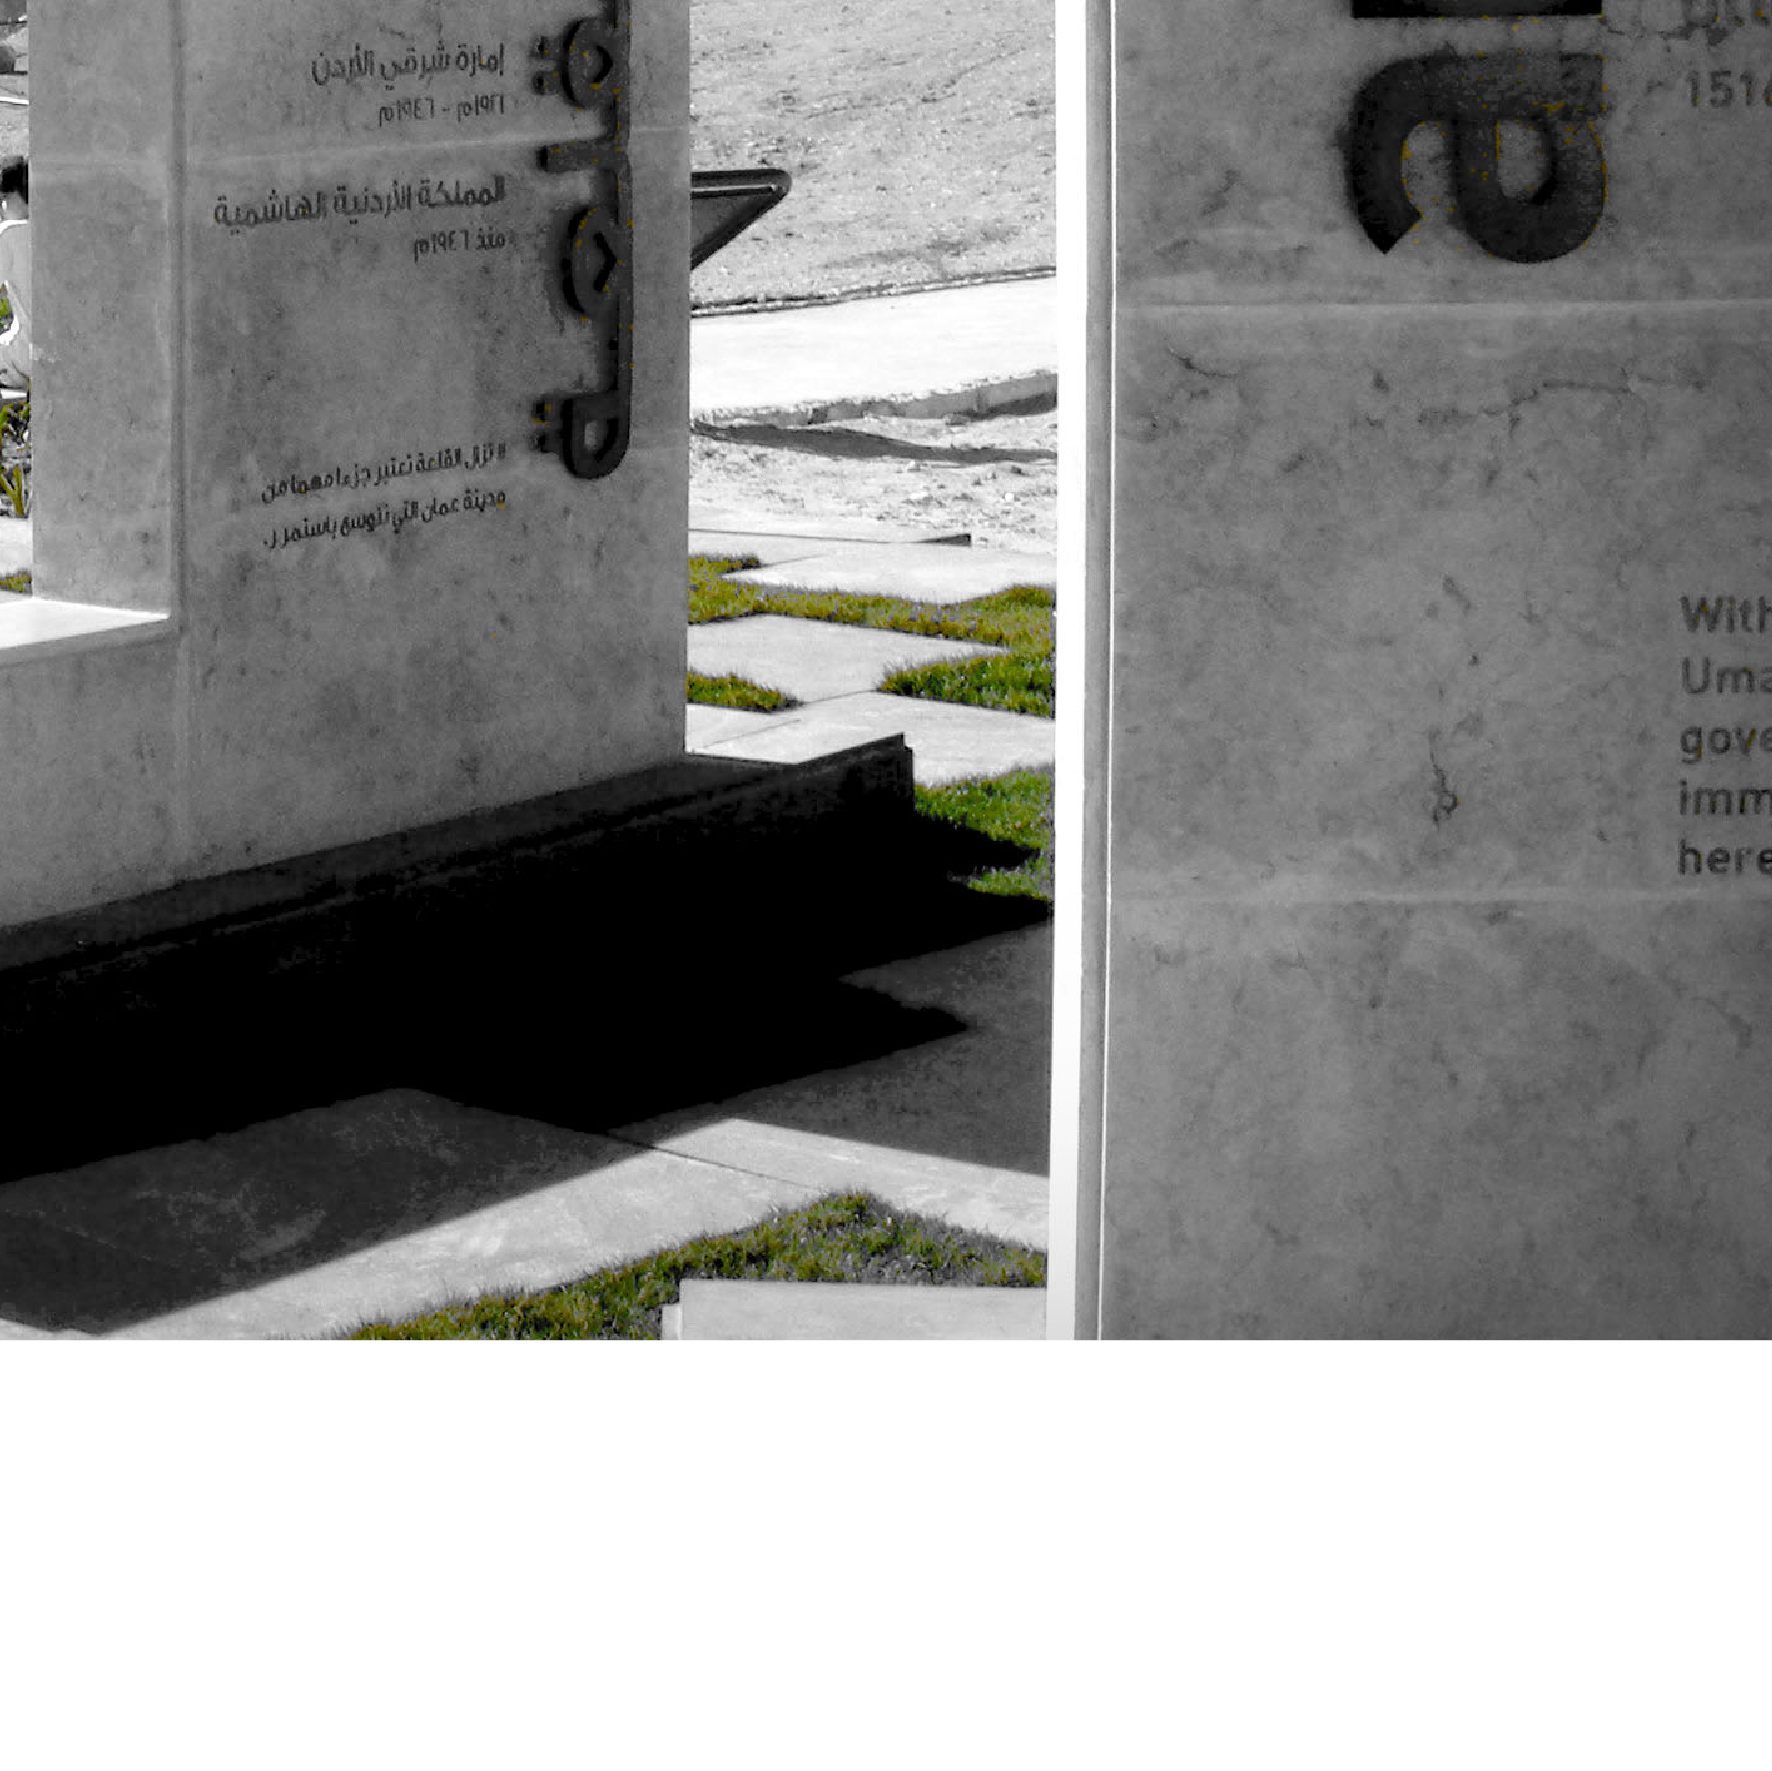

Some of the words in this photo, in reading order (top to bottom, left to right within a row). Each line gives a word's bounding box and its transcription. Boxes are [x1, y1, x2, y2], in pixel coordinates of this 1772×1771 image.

[381, 41, 451, 90] شرقي
[214, 189, 327, 235] الهاشمية
[419, 175, 505, 209] المملكة
